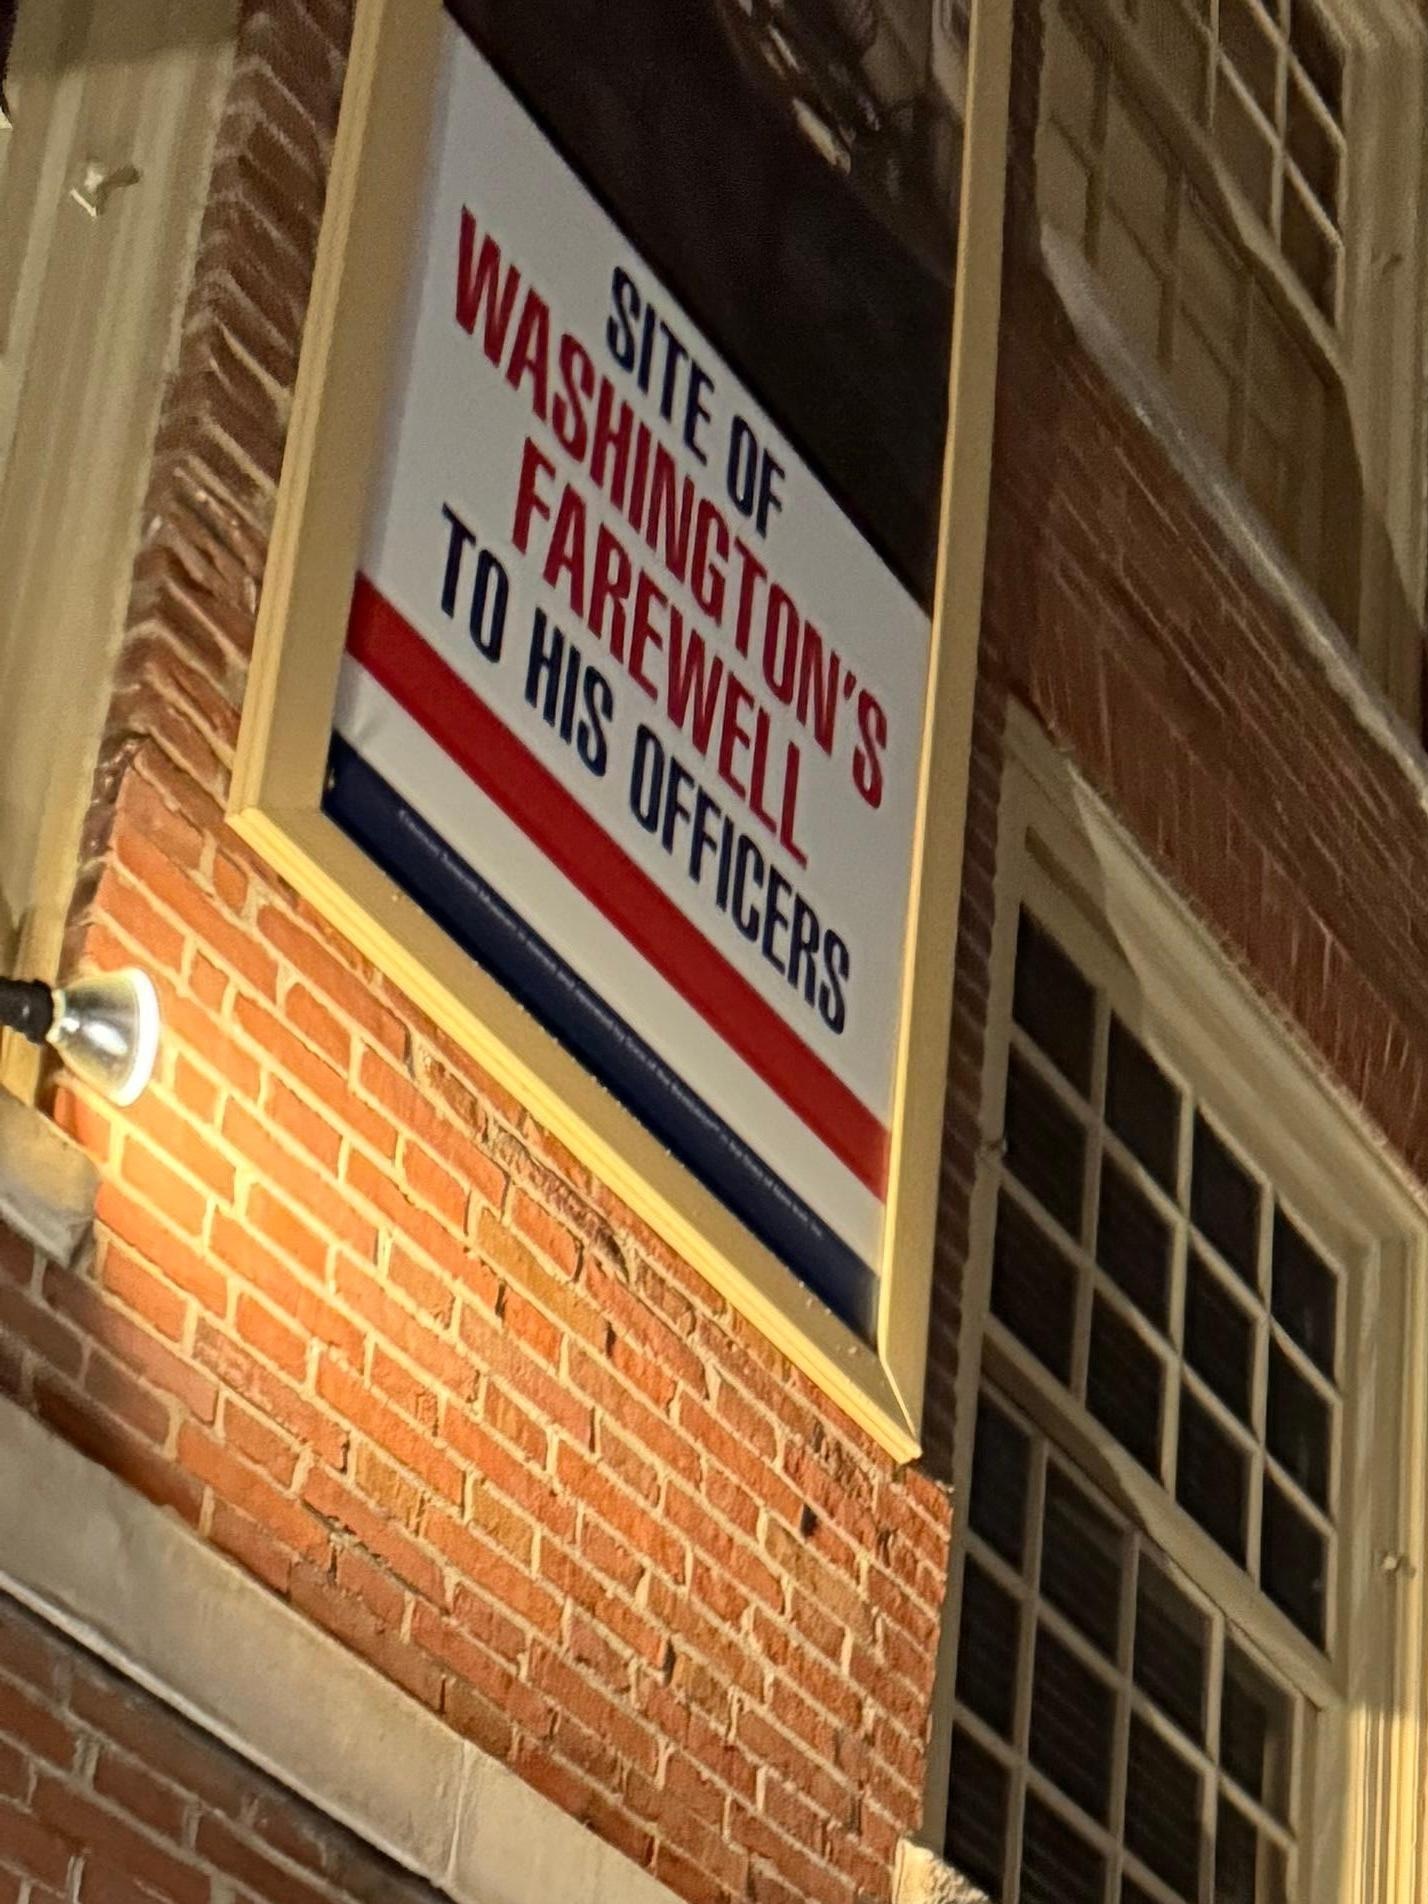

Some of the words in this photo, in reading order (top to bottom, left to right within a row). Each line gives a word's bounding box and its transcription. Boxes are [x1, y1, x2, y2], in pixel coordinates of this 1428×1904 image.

[455, 203, 887, 809] WASHINGTON'S
[607, 266, 714, 466] SITE
[726, 415, 786, 540] OF
[440, 502, 510, 664] TO
[524, 606, 614, 778] HIS
[629, 723, 850, 1035] OFFICERS
[511, 436, 807, 870] FAREWELL
